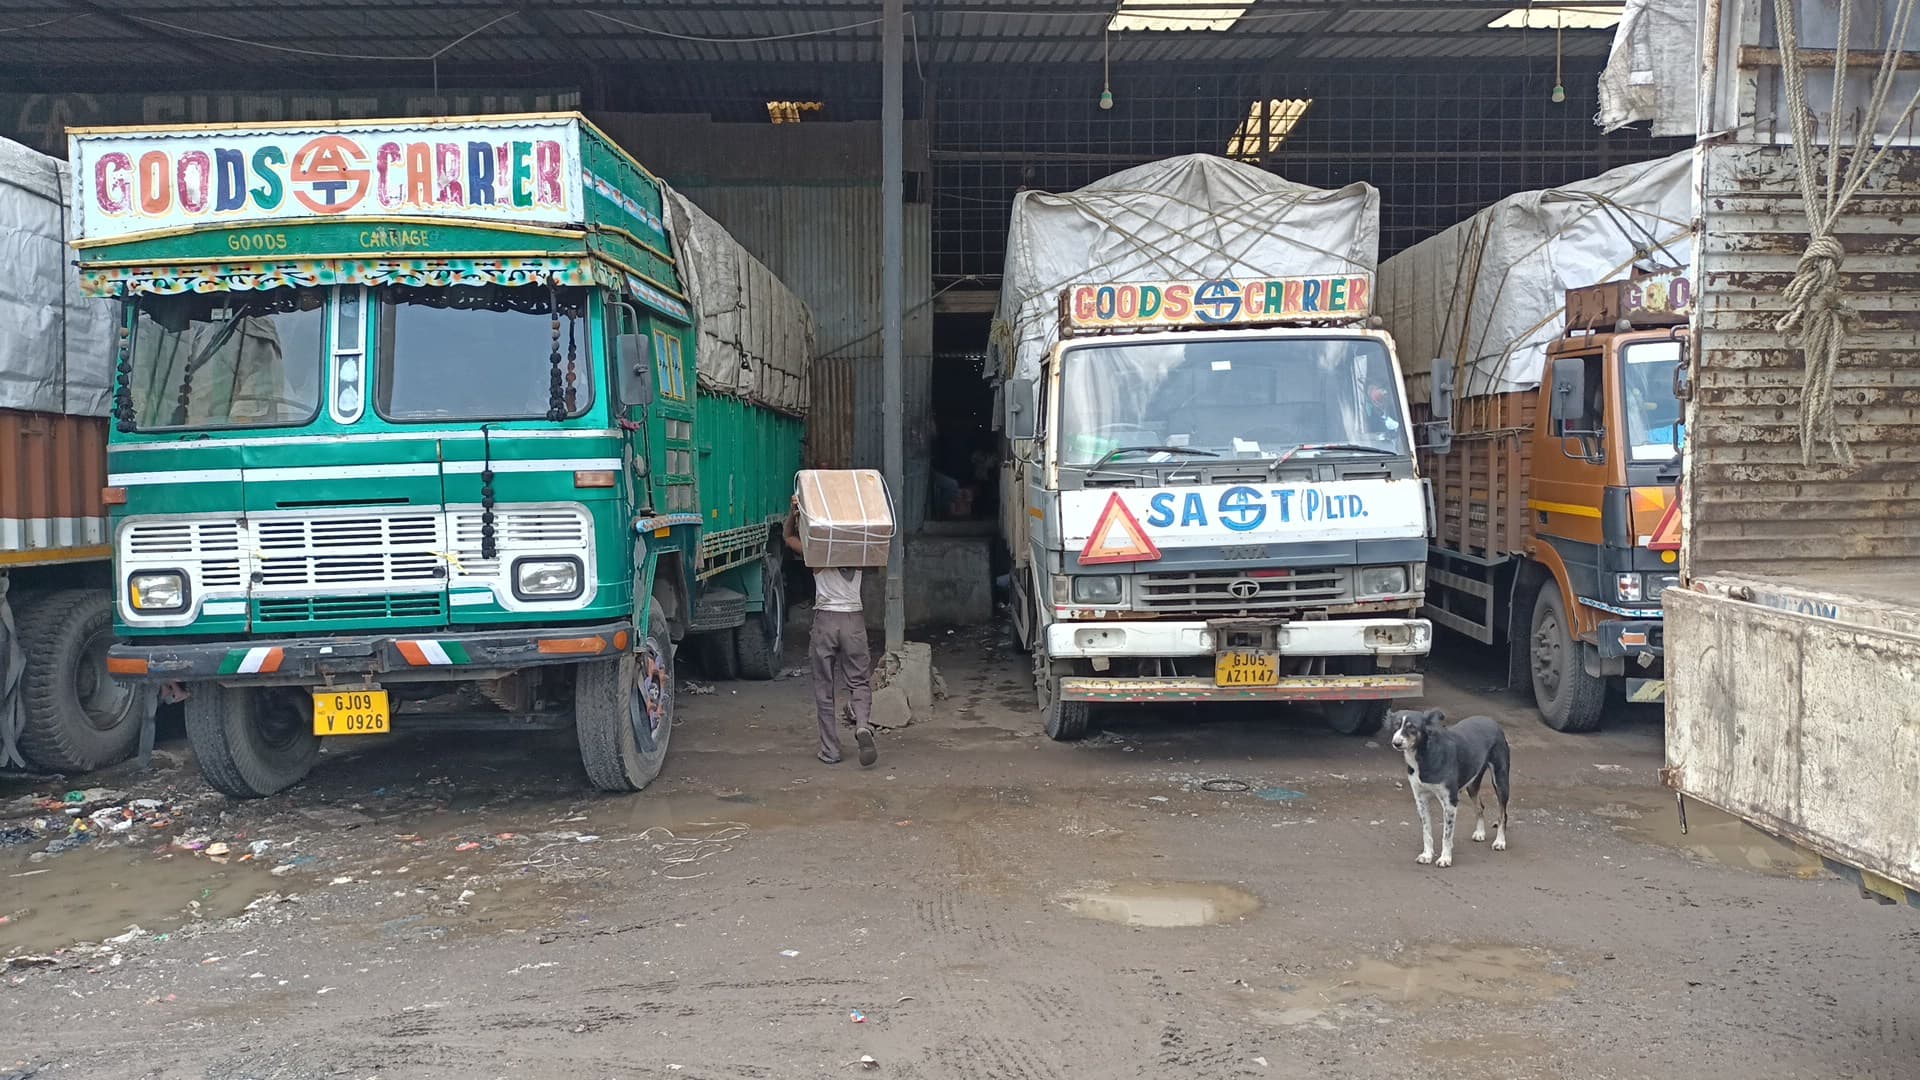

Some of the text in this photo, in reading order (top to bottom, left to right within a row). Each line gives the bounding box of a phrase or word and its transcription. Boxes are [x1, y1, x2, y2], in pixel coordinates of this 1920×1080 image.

[95, 145, 286, 214] GOODS
[377, 140, 564, 208] CARRIER
[228, 233, 287, 250] GOODS
[1075, 284, 1191, 320] GOODS
[1244, 277, 1369, 315] CARRIER
[1222, 545, 1271, 561] TATA
[1233, 653, 1265, 666] GJ05
[1226, 669, 1274, 683] AZ1147
[335, 694, 371, 711] GJ09
[327, 713, 383, 731] V 0926
